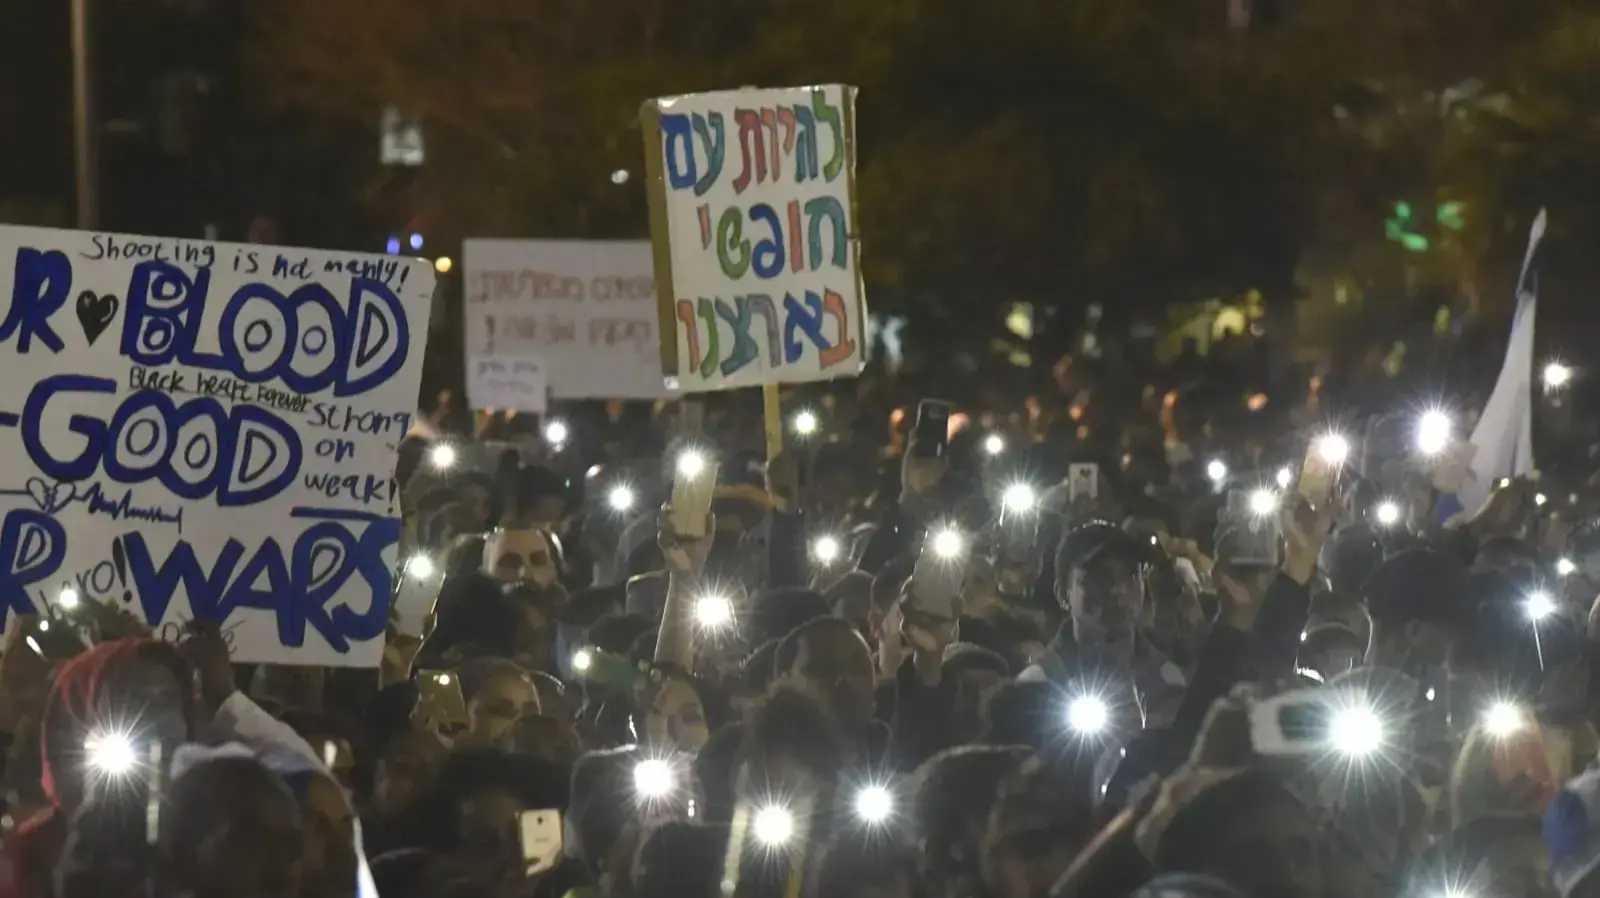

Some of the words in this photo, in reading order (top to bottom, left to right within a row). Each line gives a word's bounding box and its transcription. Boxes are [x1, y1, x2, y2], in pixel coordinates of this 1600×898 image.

[659, 110, 725, 196] עם
[78, 234, 215, 269] Shooting
[233, 249, 259, 273] is
[696, 196, 847, 280] חופשי
[120, 261, 409, 396] BLOOD
[677, 286, 855, 379] בארצנו
[129, 365, 185, 393] Black
[197, 371, 251, 402] heart
[315, 438, 354, 463] on
[304, 473, 397, 514] weak!
[122, 517, 401, 653] WARS
